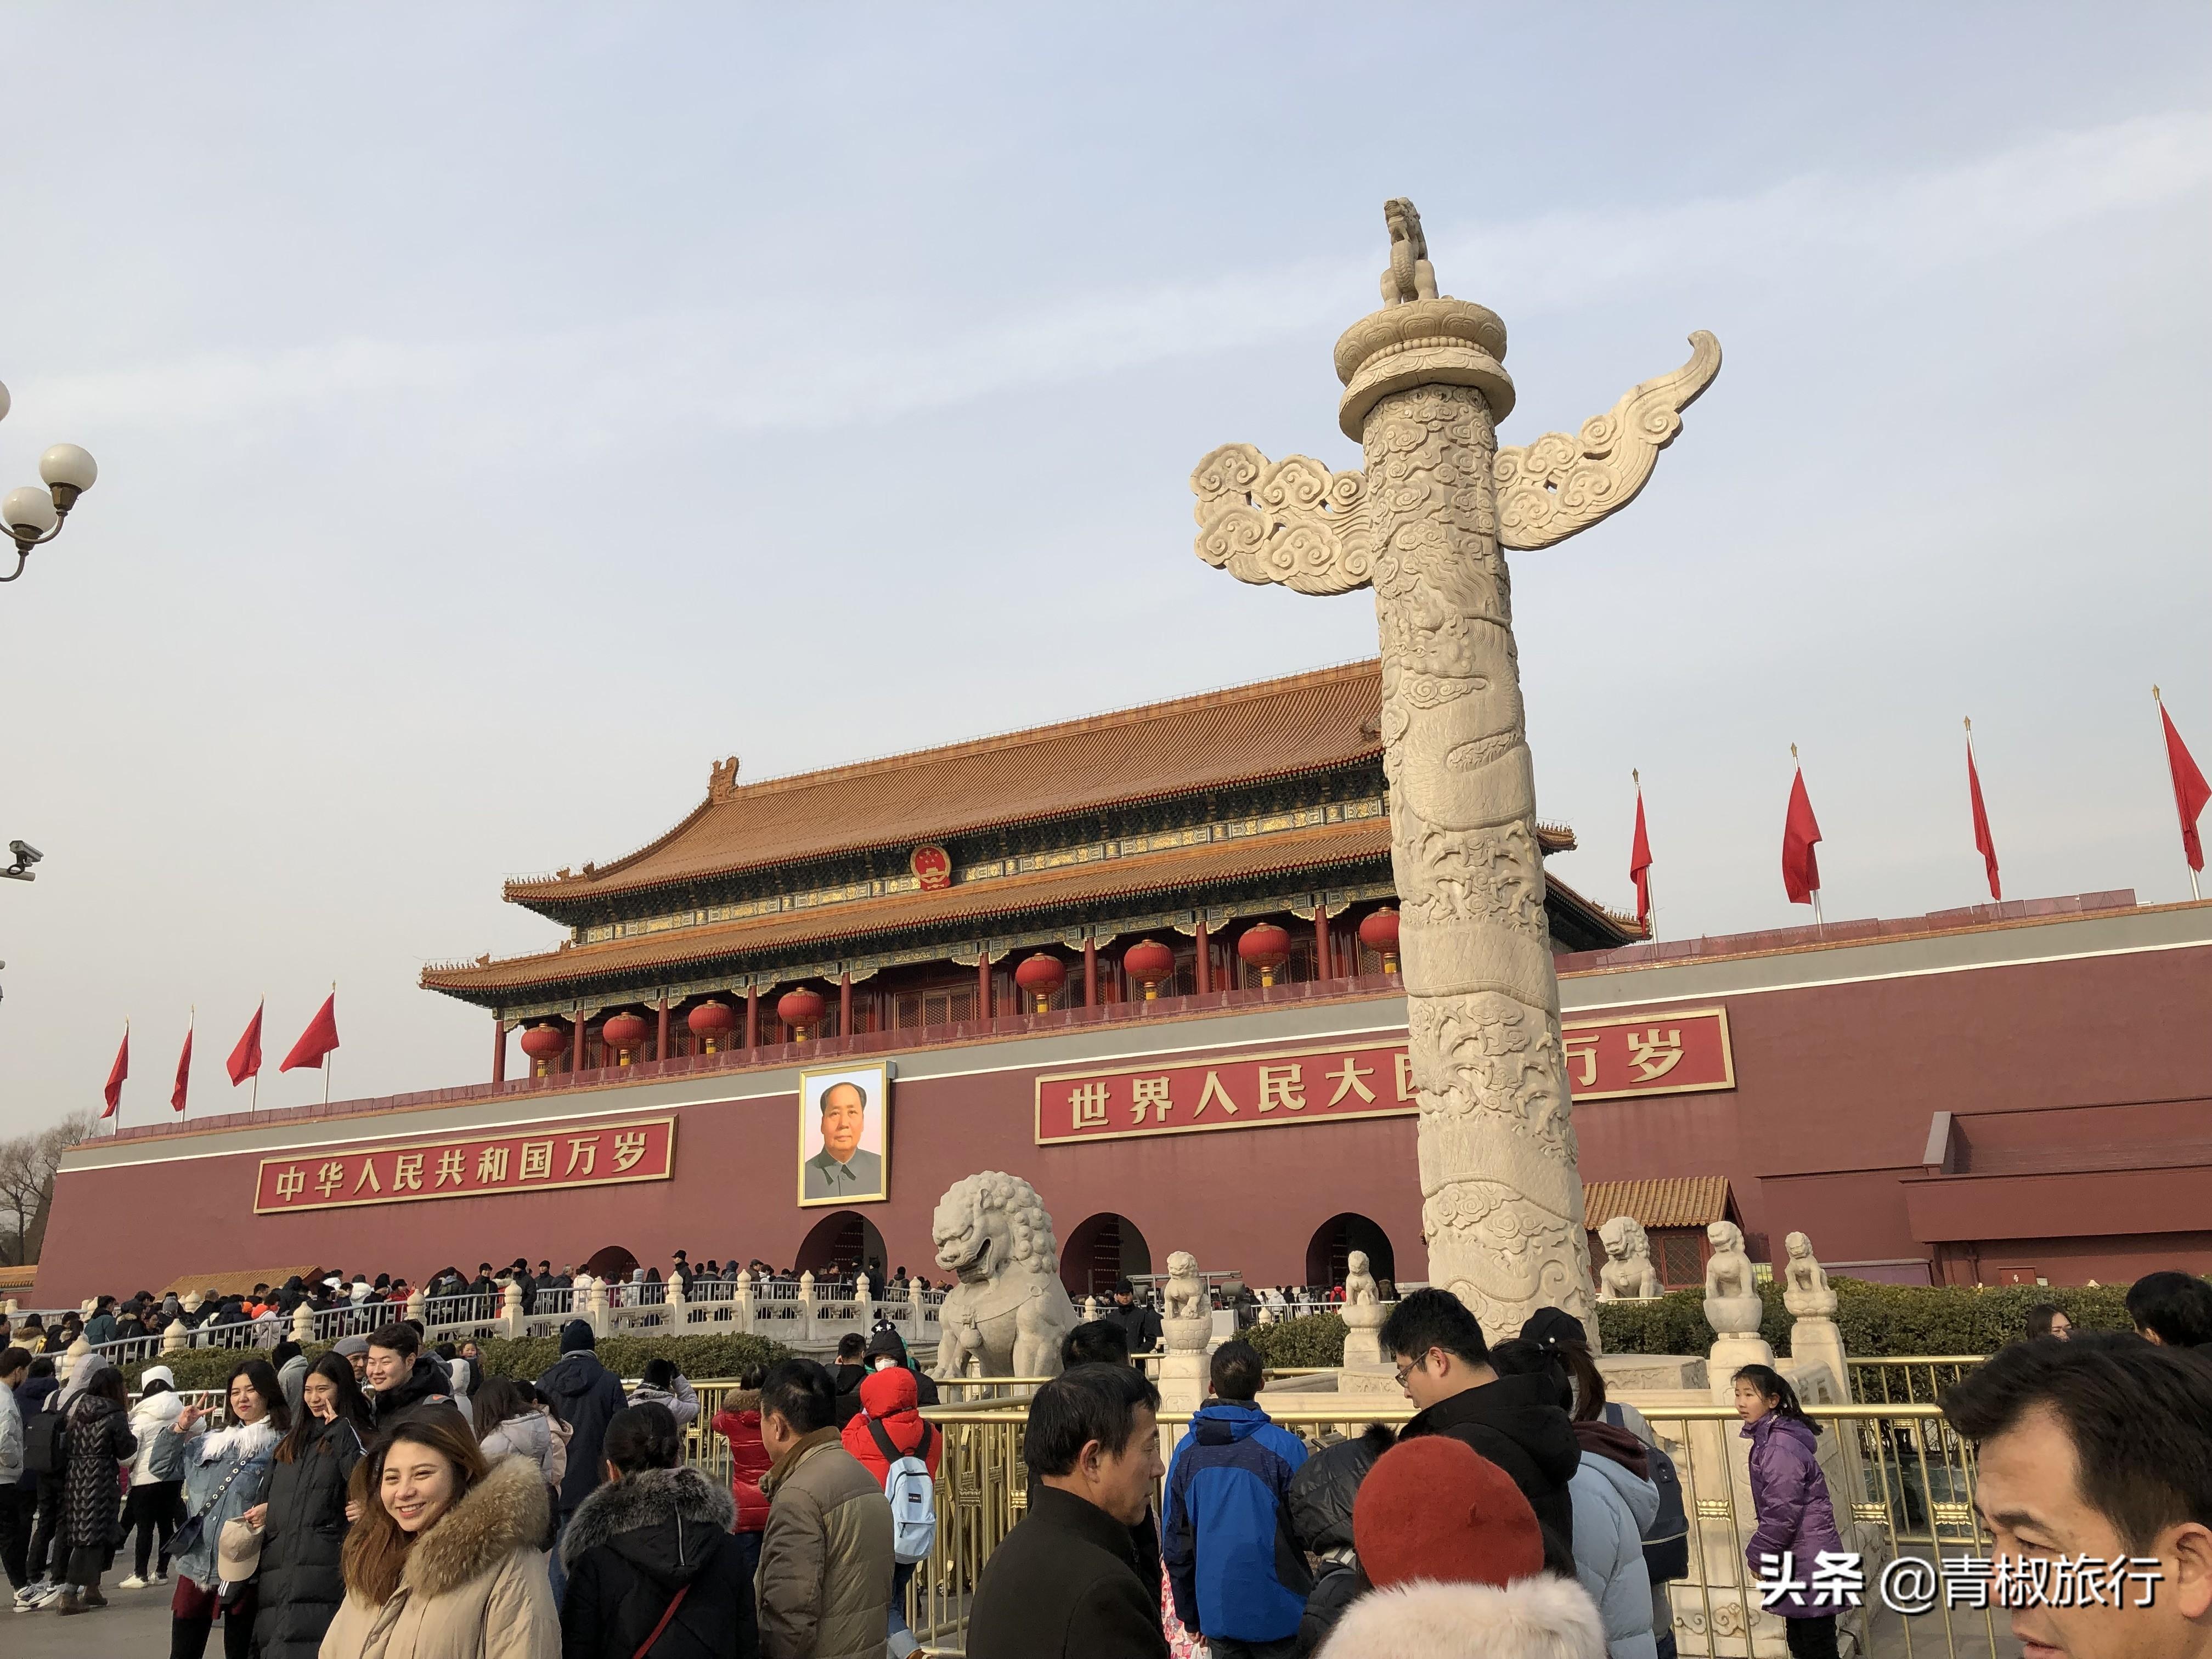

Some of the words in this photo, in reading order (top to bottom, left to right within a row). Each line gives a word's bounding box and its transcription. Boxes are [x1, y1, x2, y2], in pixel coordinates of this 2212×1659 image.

[275, 1132, 647, 1201] 中华人民共和国万岁
